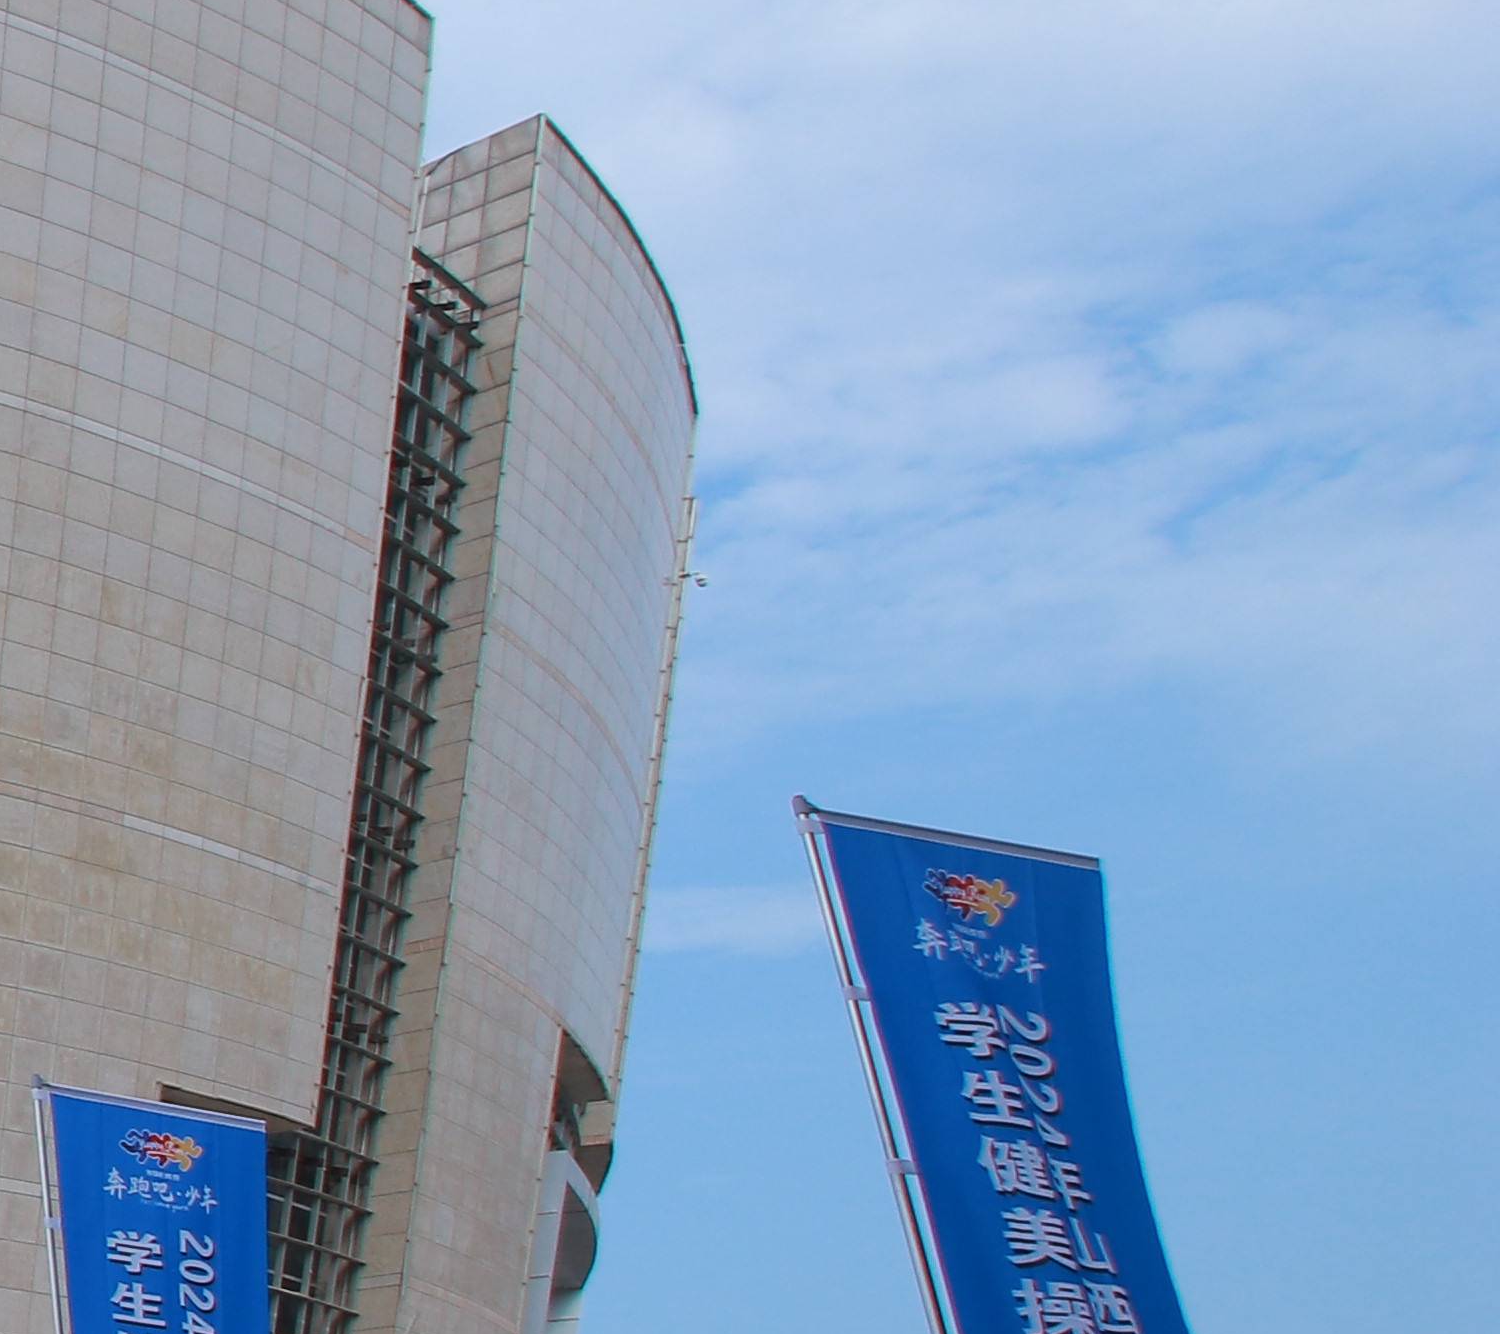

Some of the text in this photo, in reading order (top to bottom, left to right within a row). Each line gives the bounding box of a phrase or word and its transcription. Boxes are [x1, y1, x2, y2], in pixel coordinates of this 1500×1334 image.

[103, 1166, 219, 1214] 奔跑吧·少年
